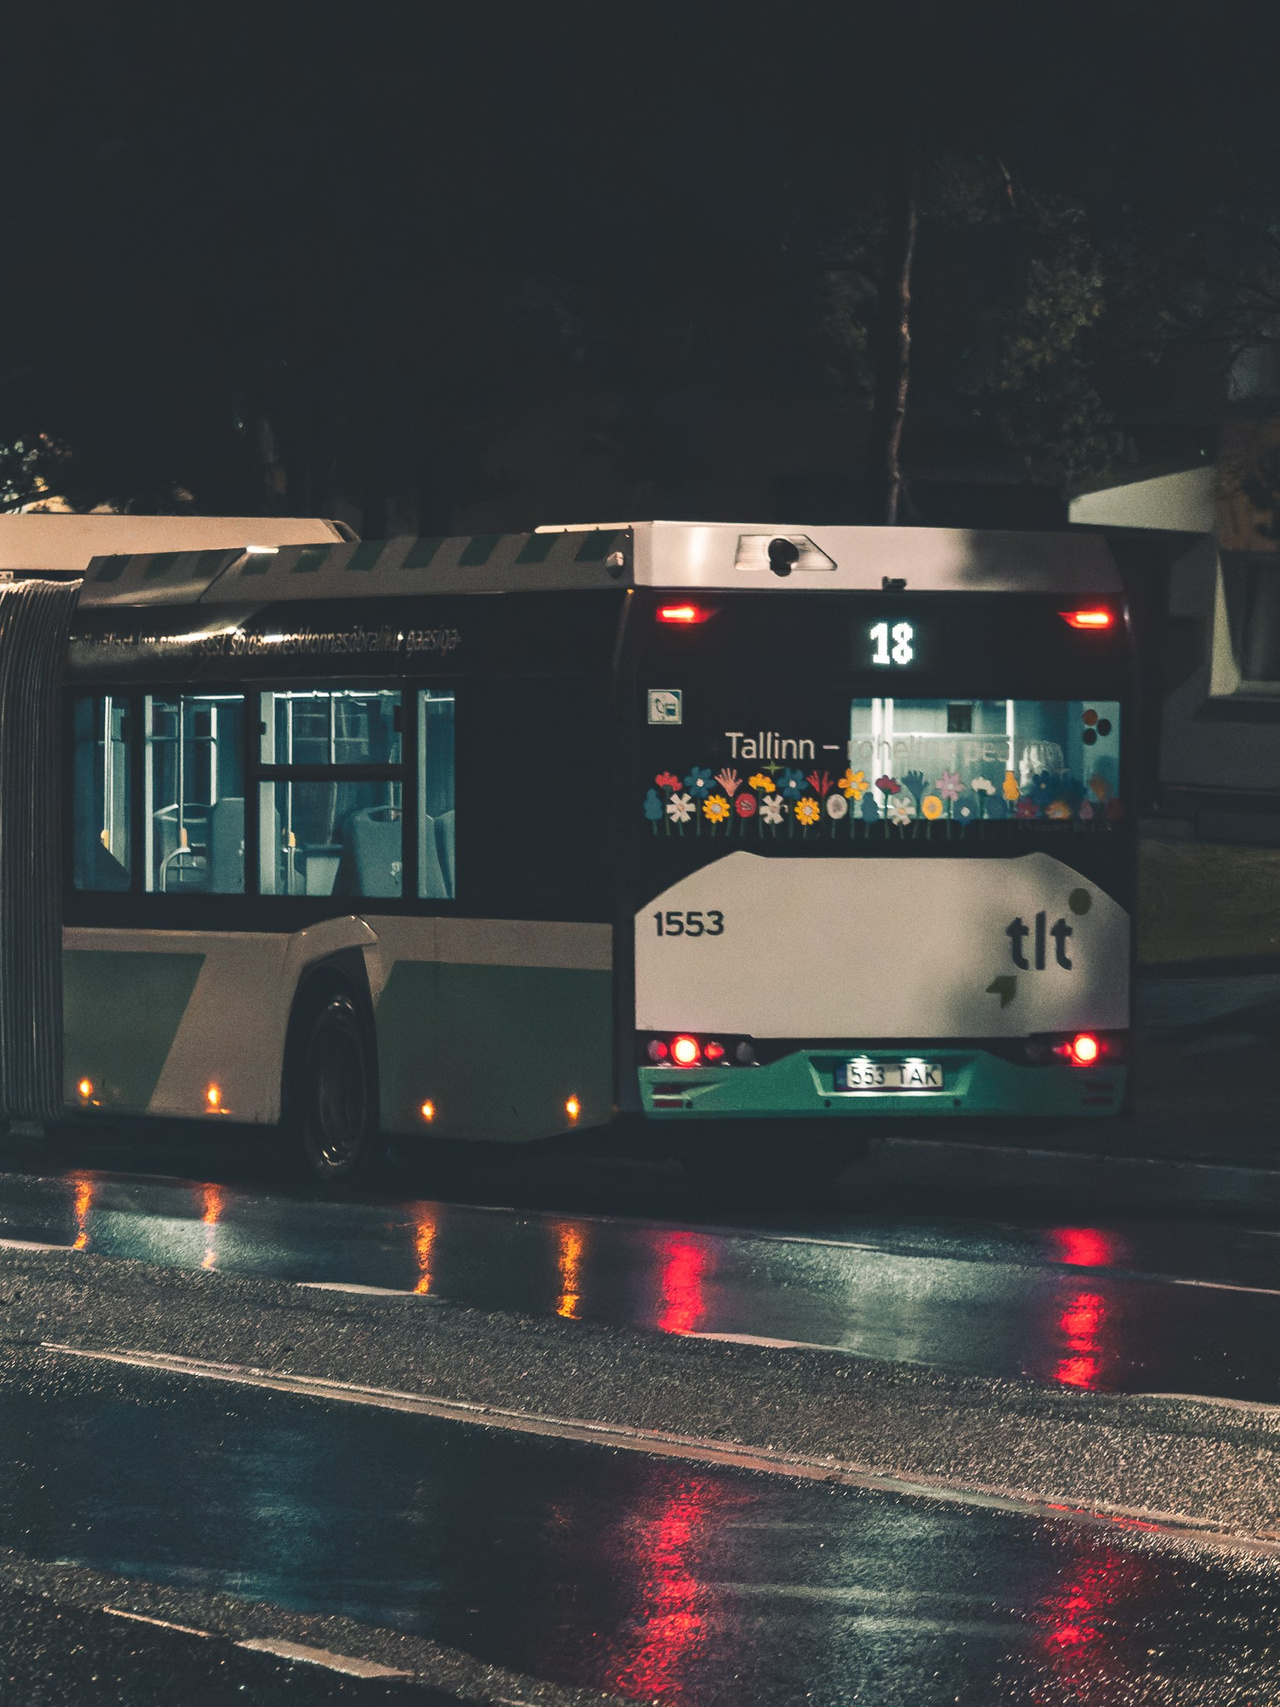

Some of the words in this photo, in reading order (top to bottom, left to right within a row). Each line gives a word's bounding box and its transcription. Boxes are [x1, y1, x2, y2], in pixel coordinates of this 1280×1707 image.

[870, 622, 914, 664] 18
[726, 732, 815, 760] Tallinn
[654, 911, 725, 937] 1553
[1006, 912, 1073, 971] tlt
[851, 1065, 885, 1086] 553
[898, 1063, 939, 1086] TAK
